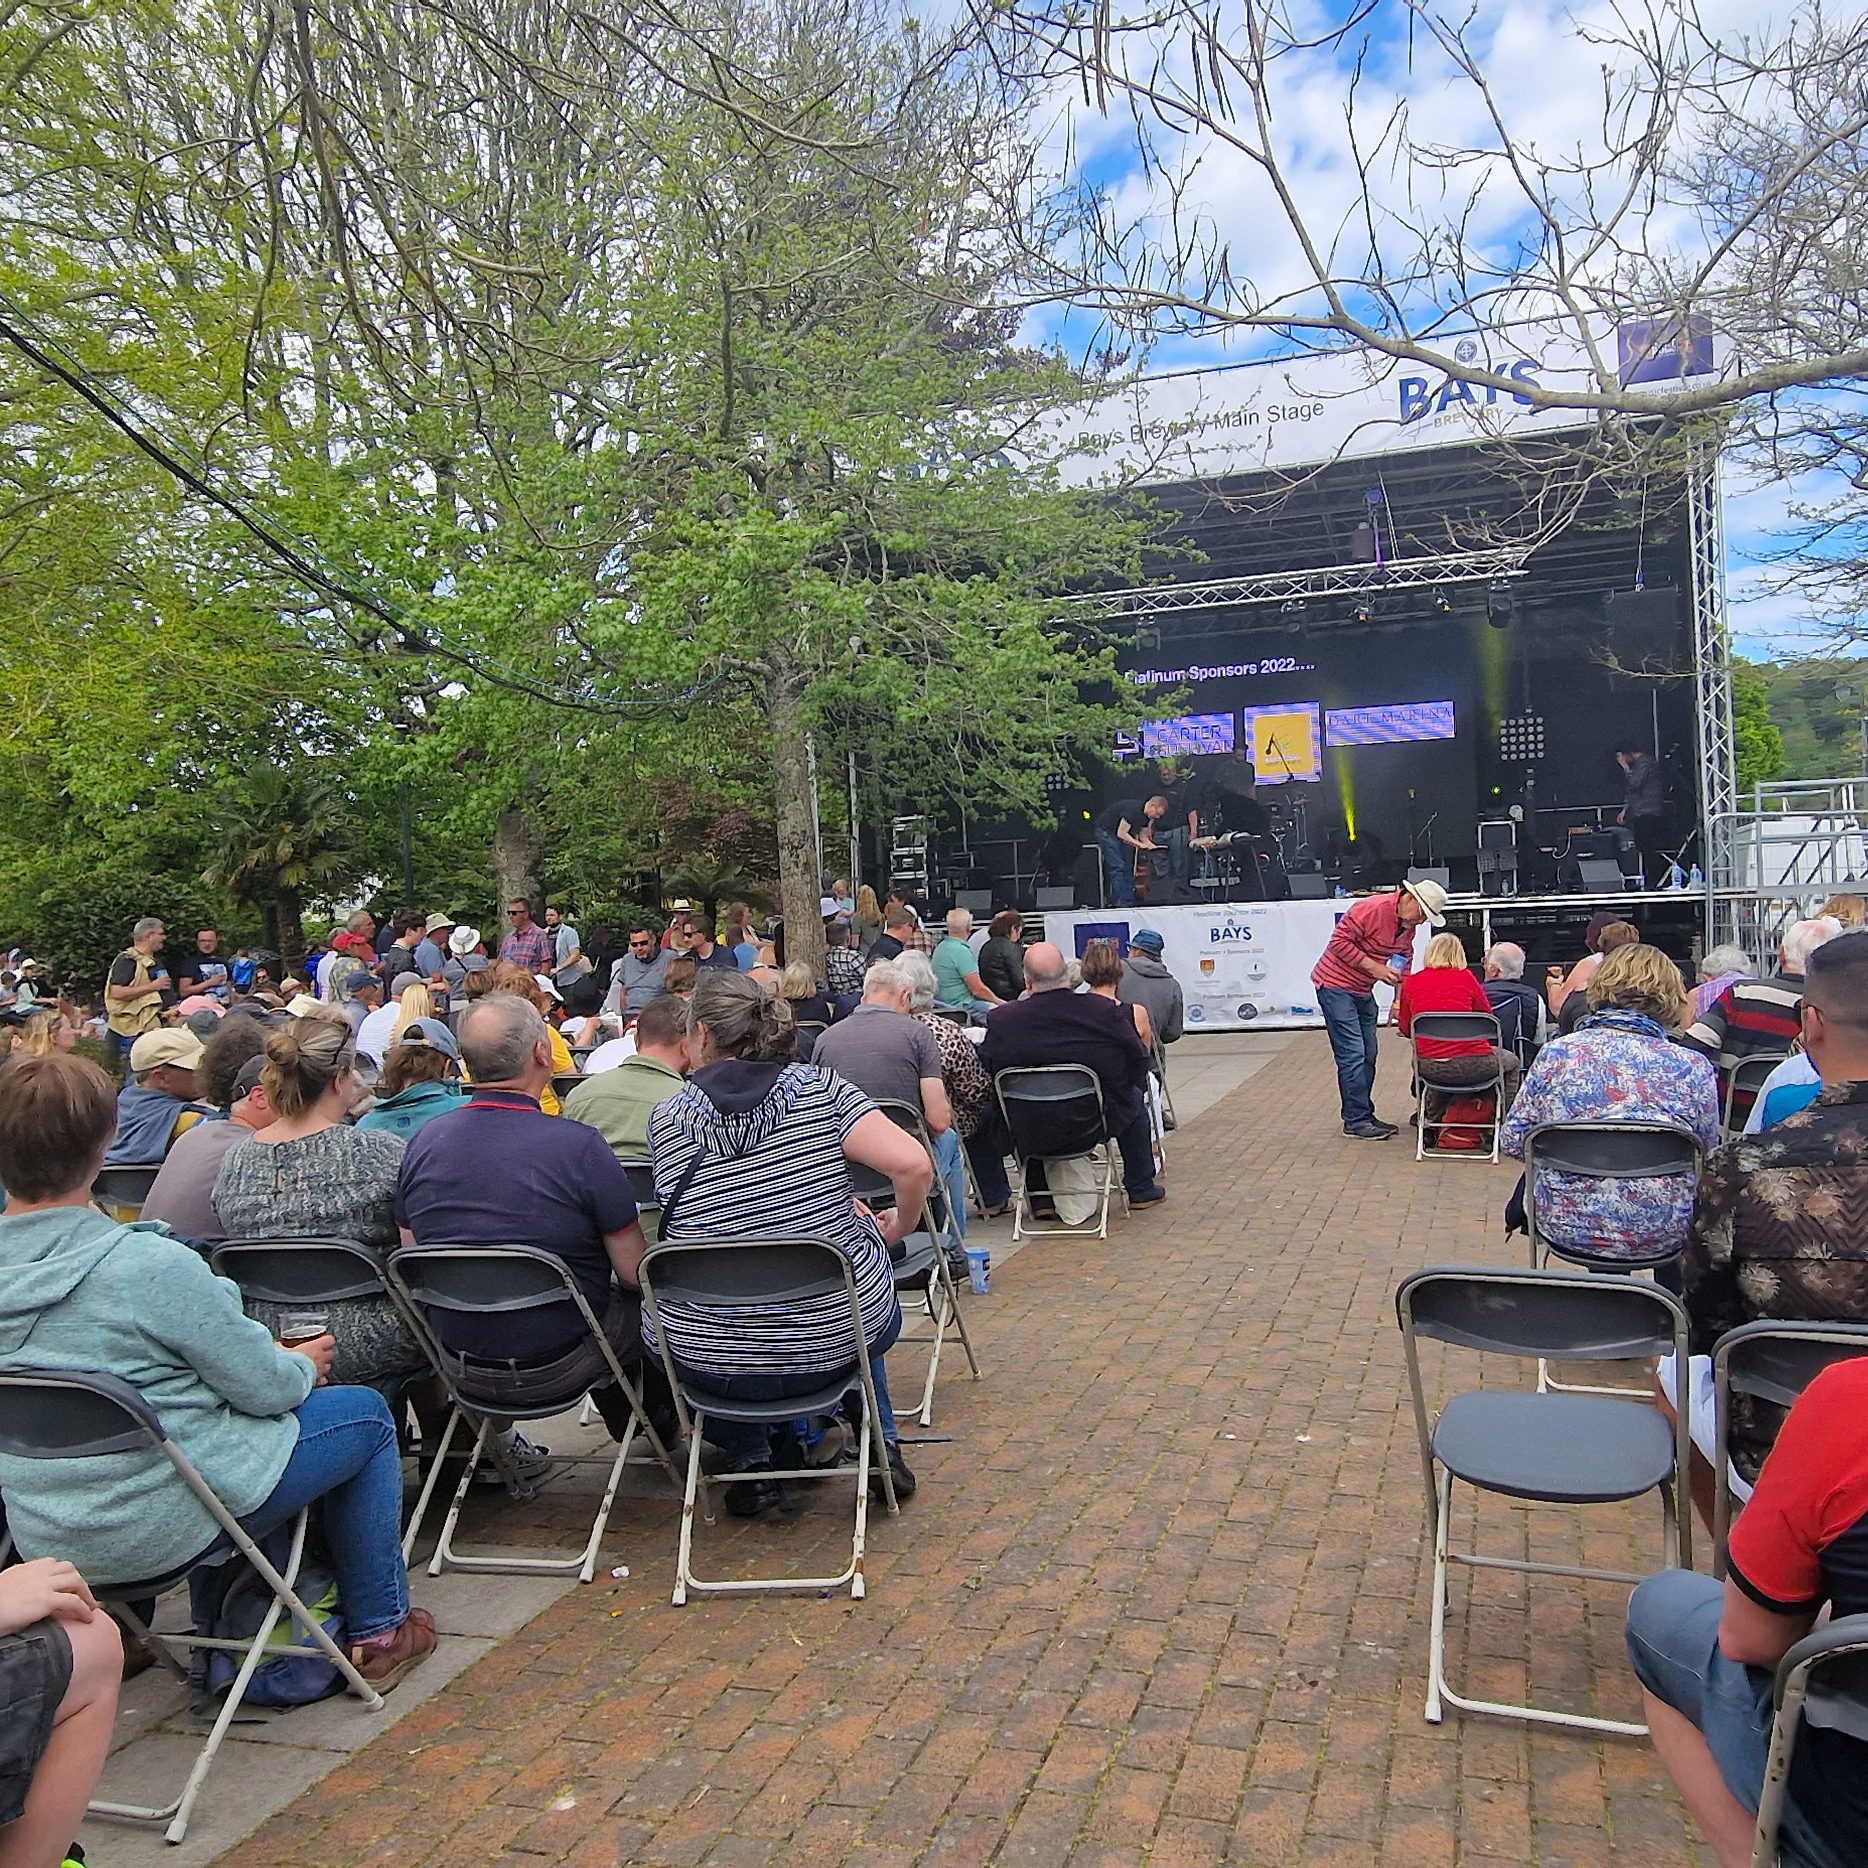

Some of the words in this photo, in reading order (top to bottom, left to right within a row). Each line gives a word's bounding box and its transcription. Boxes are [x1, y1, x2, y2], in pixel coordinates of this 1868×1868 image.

[1398, 358, 1542, 426] BAYS
[1213, 410, 1260, 430] Main
[1266, 401, 1326, 423] Stage
[1433, 407, 1504, 428] BRERY
[1125, 668, 1187, 685] Platinum
[1188, 664, 1258, 683] Sponsors
[1328, 712, 1371, 726] DART
[1380, 706, 1452, 722] MARINA
[1157, 724, 1222, 742] CARTER
[1210, 926, 1252, 943] BAYS
